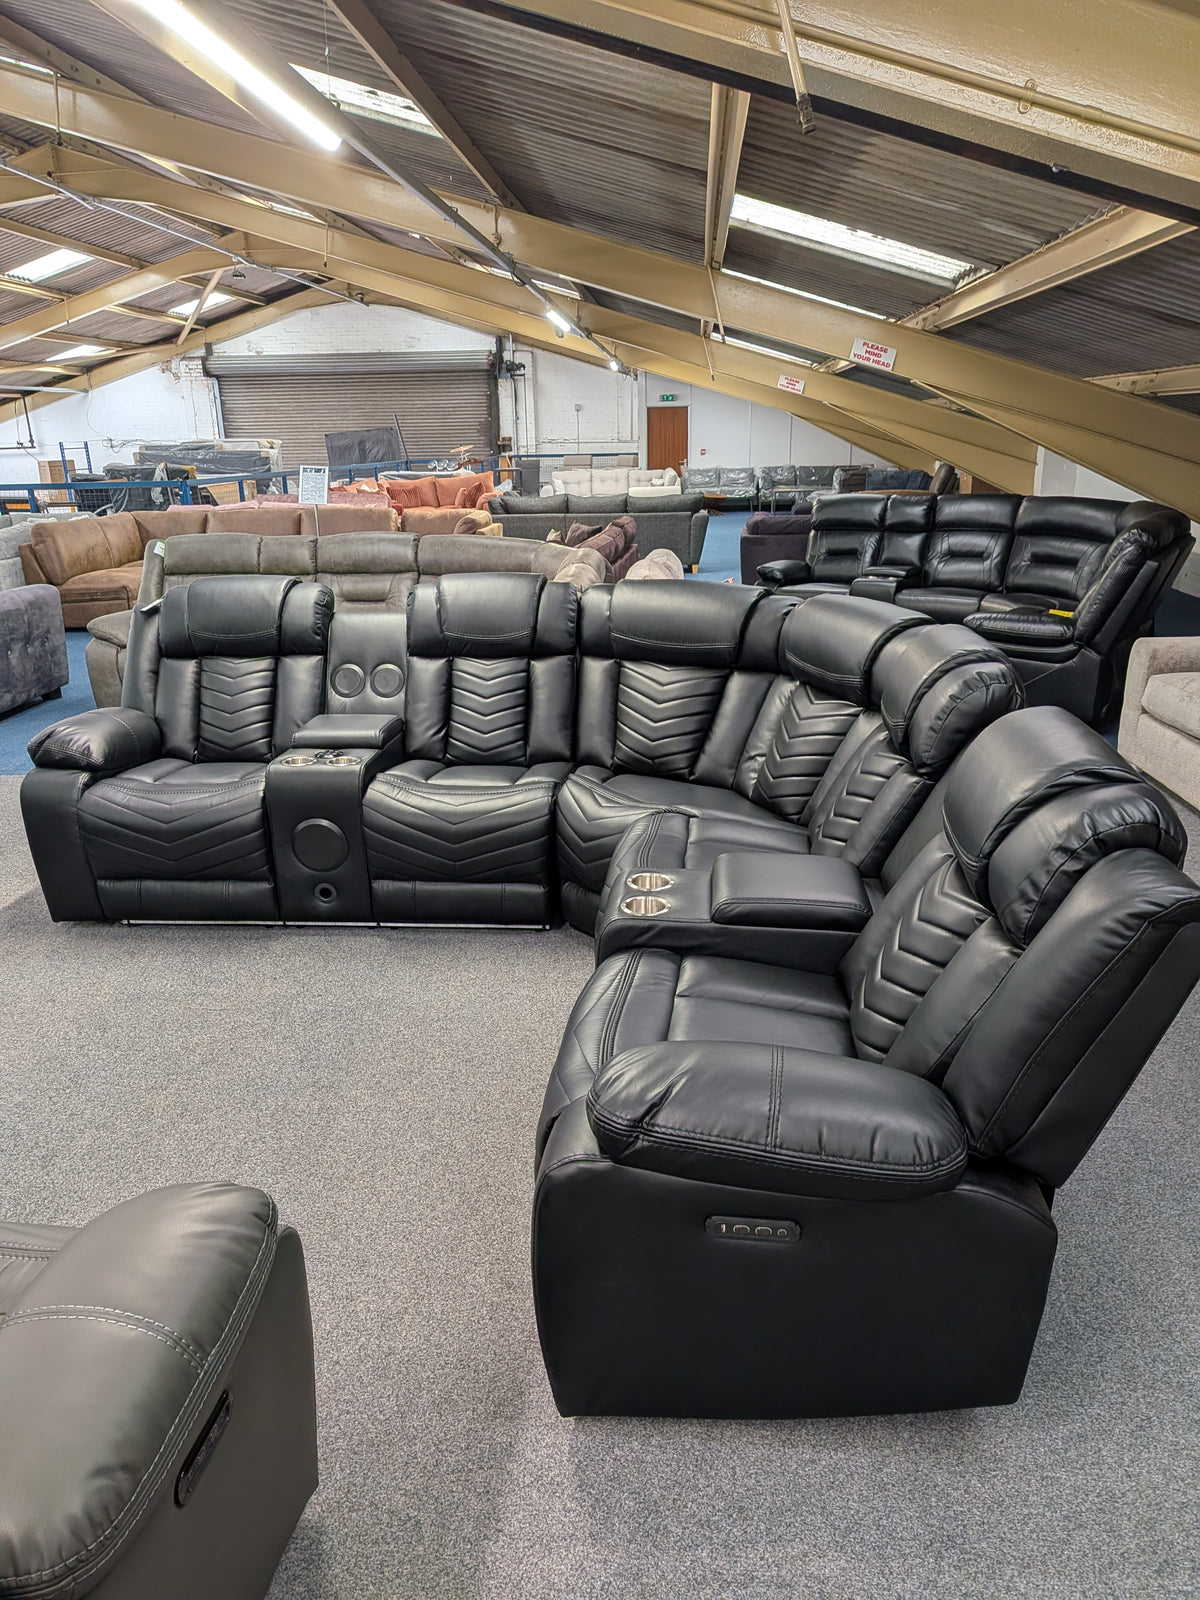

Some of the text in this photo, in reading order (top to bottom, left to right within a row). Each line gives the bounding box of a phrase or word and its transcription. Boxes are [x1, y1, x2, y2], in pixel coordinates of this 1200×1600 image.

[862, 341, 888, 353] PLEASE
[865, 349, 882, 358] MIND
[853, 352, 891, 368] YOUR HEAD
